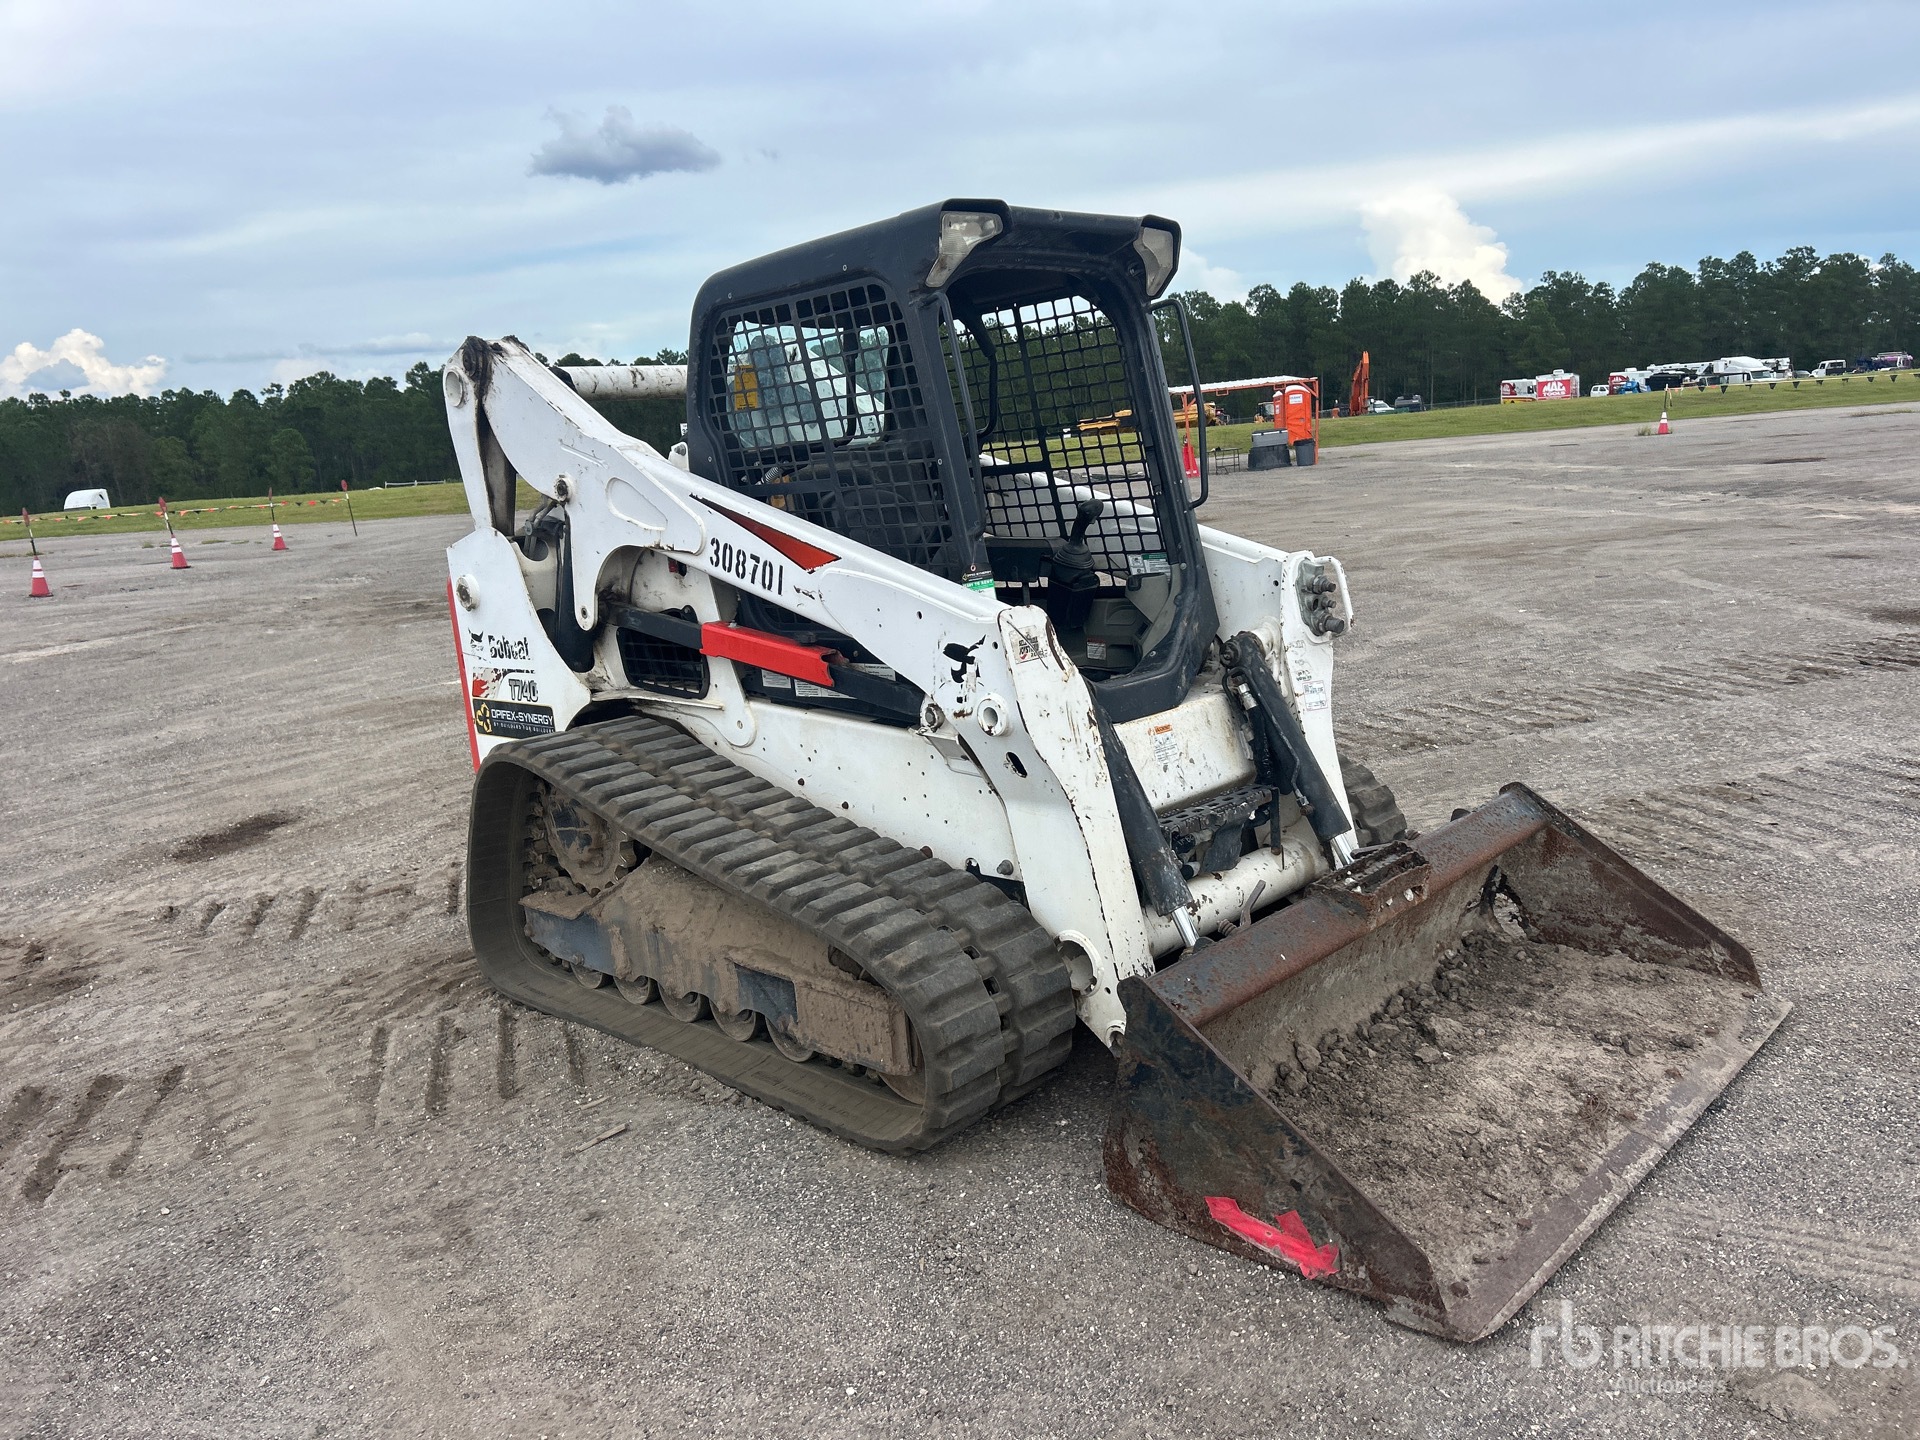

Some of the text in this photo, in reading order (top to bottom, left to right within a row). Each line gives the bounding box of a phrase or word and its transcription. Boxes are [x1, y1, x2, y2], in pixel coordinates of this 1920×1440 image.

[1542, 381, 1566, 392] MAC
[709, 537, 784, 596] 308701
[508, 678, 539, 703] T740
[490, 708, 554, 726] OPIFEX-SYNERGY
